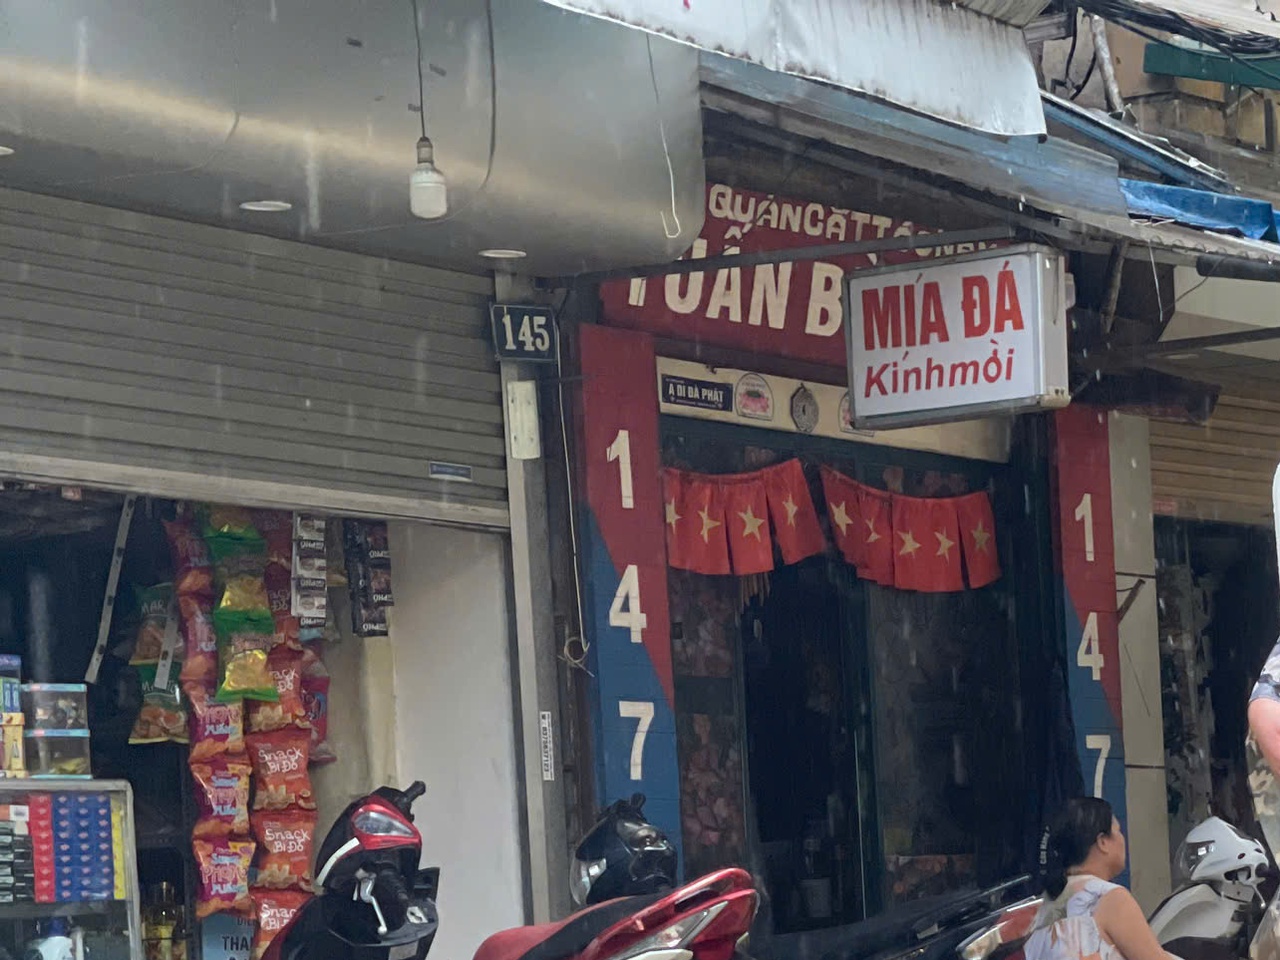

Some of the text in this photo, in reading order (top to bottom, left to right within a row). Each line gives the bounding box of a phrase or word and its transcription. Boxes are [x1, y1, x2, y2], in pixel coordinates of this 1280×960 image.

[862, 260, 1025, 351] MÍA ĐÁ
[502, 314, 550, 351] 145
[265, 828, 311, 842] Snack
[222, 935, 253, 951] THA
